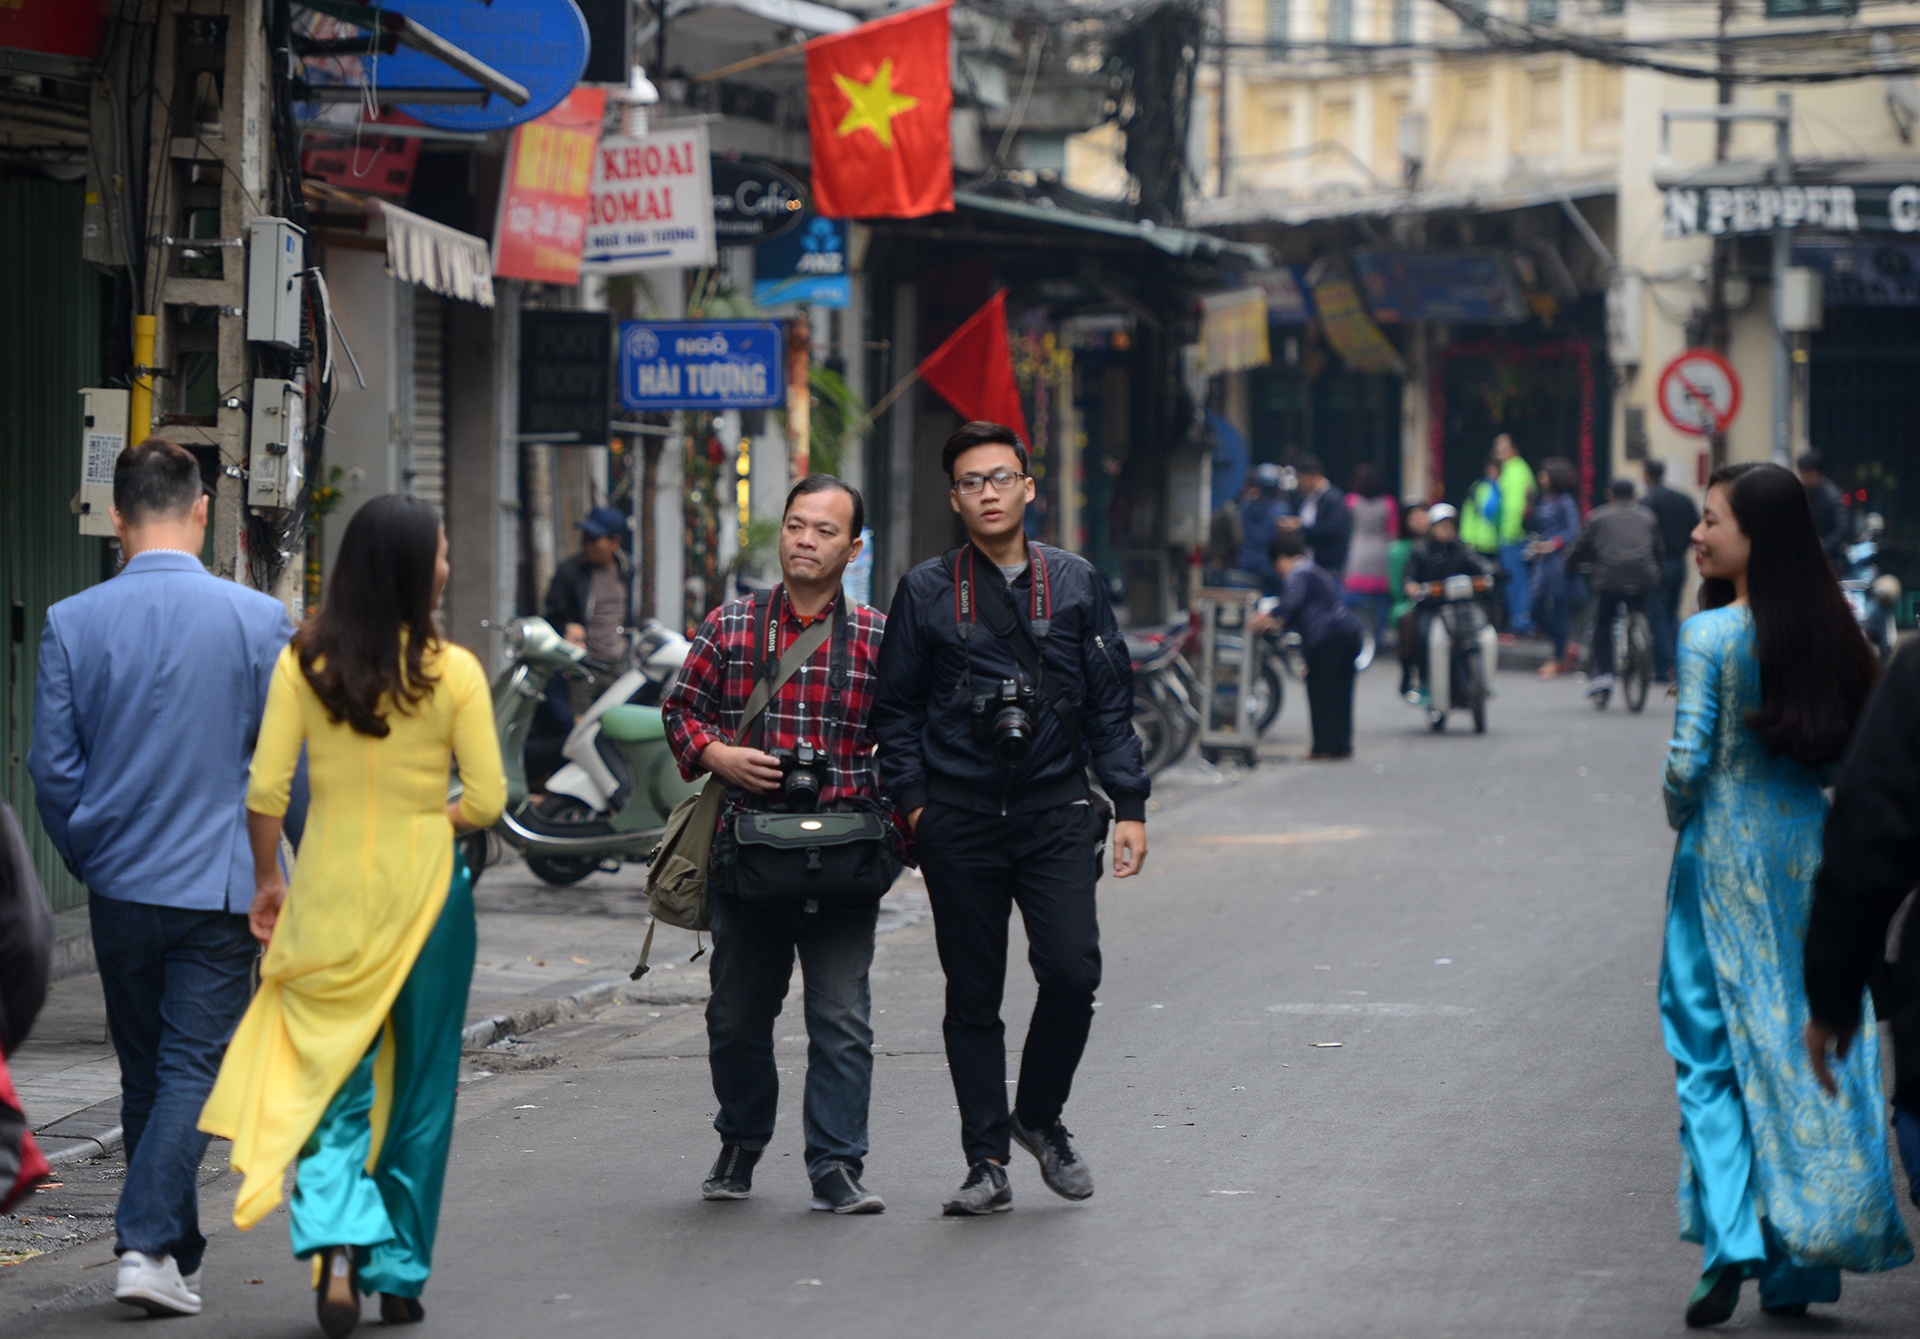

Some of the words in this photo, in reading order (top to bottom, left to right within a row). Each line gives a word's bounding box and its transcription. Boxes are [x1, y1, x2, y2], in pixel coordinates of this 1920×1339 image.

[602, 141, 694, 181] KHOAI
[1706, 185, 1859, 235] PEPPER
[638, 356, 681, 397] HÀI
[1034, 558, 1043, 581] EOS
[961, 580, 970, 614] Canon
[1036, 582, 1045, 595] 5D
[768, 619, 778, 652] Canon
